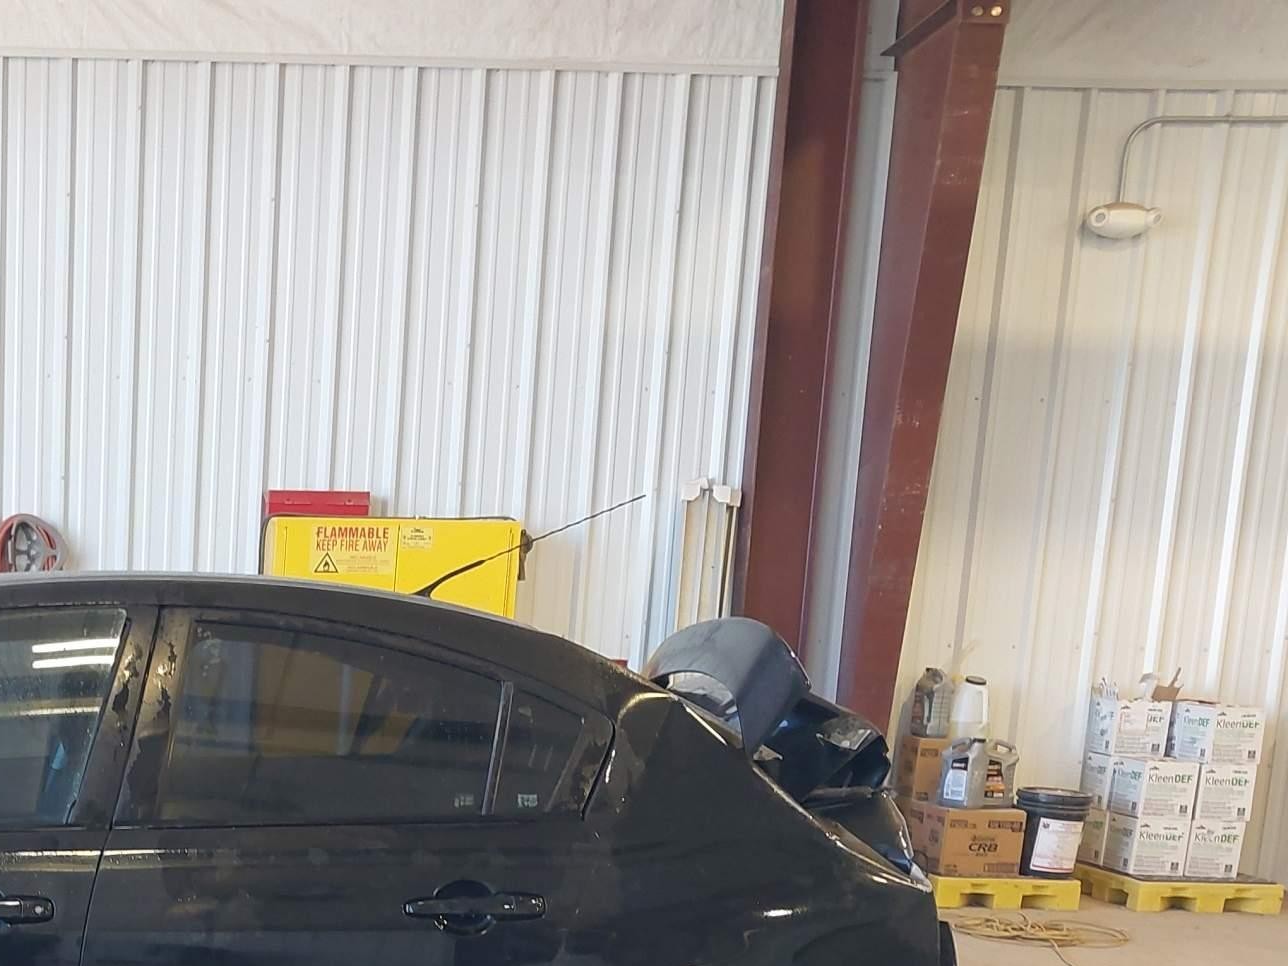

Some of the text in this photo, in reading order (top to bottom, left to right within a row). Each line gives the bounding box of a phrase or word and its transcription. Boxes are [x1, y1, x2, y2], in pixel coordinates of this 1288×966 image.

[316, 526, 390, 540] FLAMMABLE
[316, 539, 338, 552] KEEP
[340, 539, 360, 552] FIRE
[362, 539, 389, 553] AWAY
[1216, 718, 1260, 729] KleenDEF
[1148, 773, 1194, 784] KleenDEF
[1205, 775, 1250, 787] KleenDEF
[1139, 830, 1185, 841] KleenDEF
[968, 842, 999, 854] CRB
